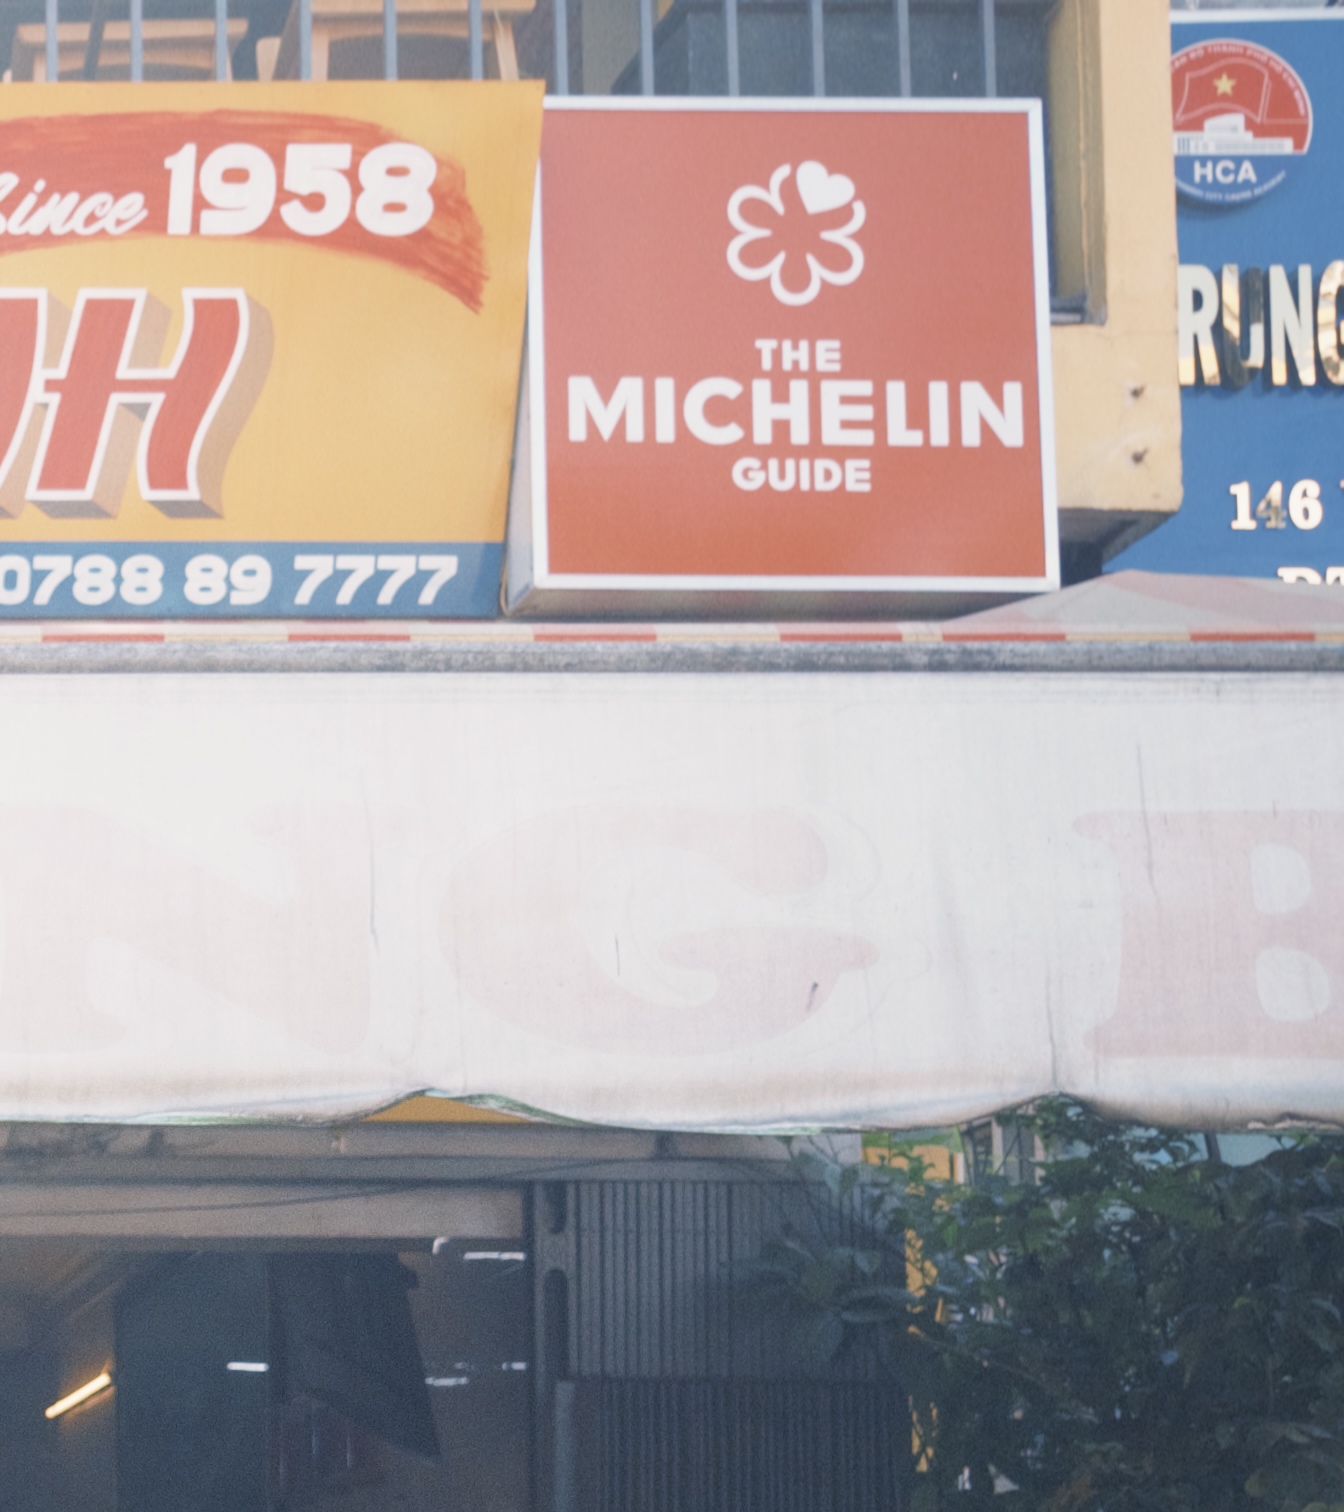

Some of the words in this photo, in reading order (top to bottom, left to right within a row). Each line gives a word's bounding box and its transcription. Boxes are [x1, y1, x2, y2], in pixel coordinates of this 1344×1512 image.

[163, 142, 438, 237] 1958
[1193, 159, 1258, 184] HCA
[754, 338, 843, 373] THE
[566, 375, 1025, 448] MICHELIN
[731, 456, 873, 493] GUIDE
[1229, 479, 1324, 530] 146
[183, 554, 273, 606] 89
[292, 554, 459, 606] 7777
